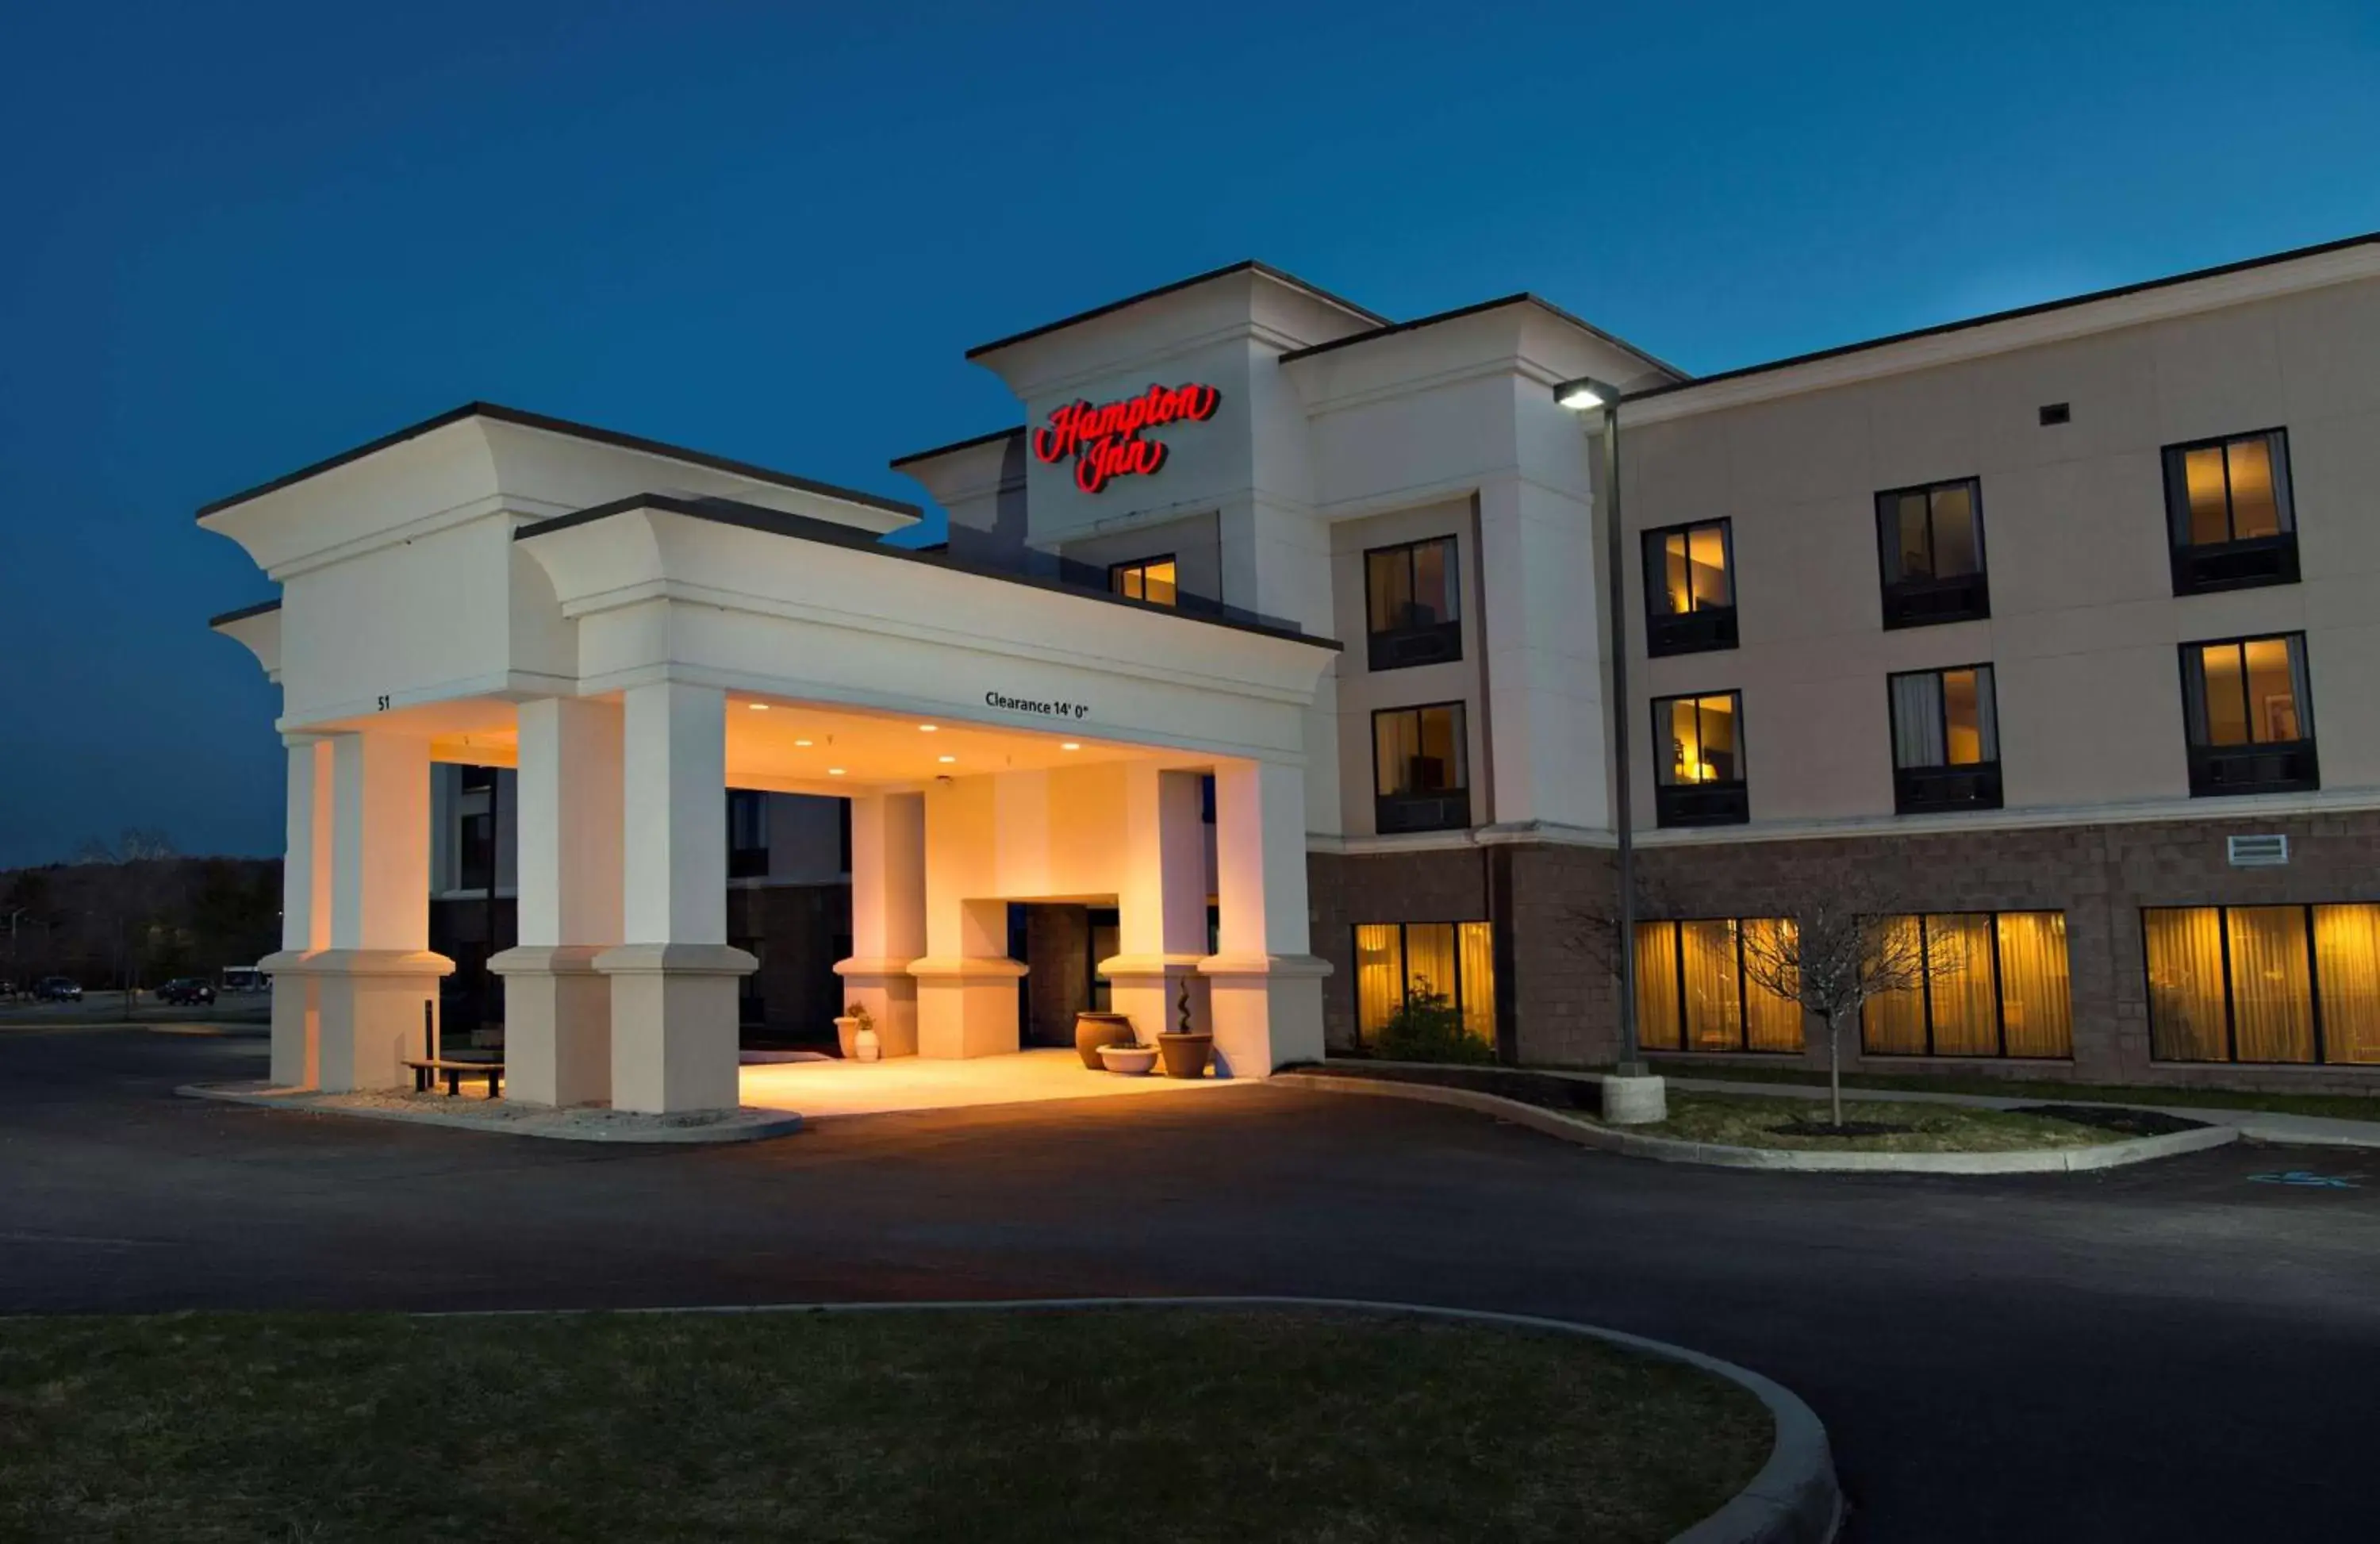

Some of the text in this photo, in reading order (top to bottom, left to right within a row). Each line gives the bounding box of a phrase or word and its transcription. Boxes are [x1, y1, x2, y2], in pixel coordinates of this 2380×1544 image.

[1034, 383, 1218, 463] Hampton
[1075, 436, 1165, 494] Inn
[378, 694, 390, 712] 51
[985, 691, 1051, 714] Clearance
